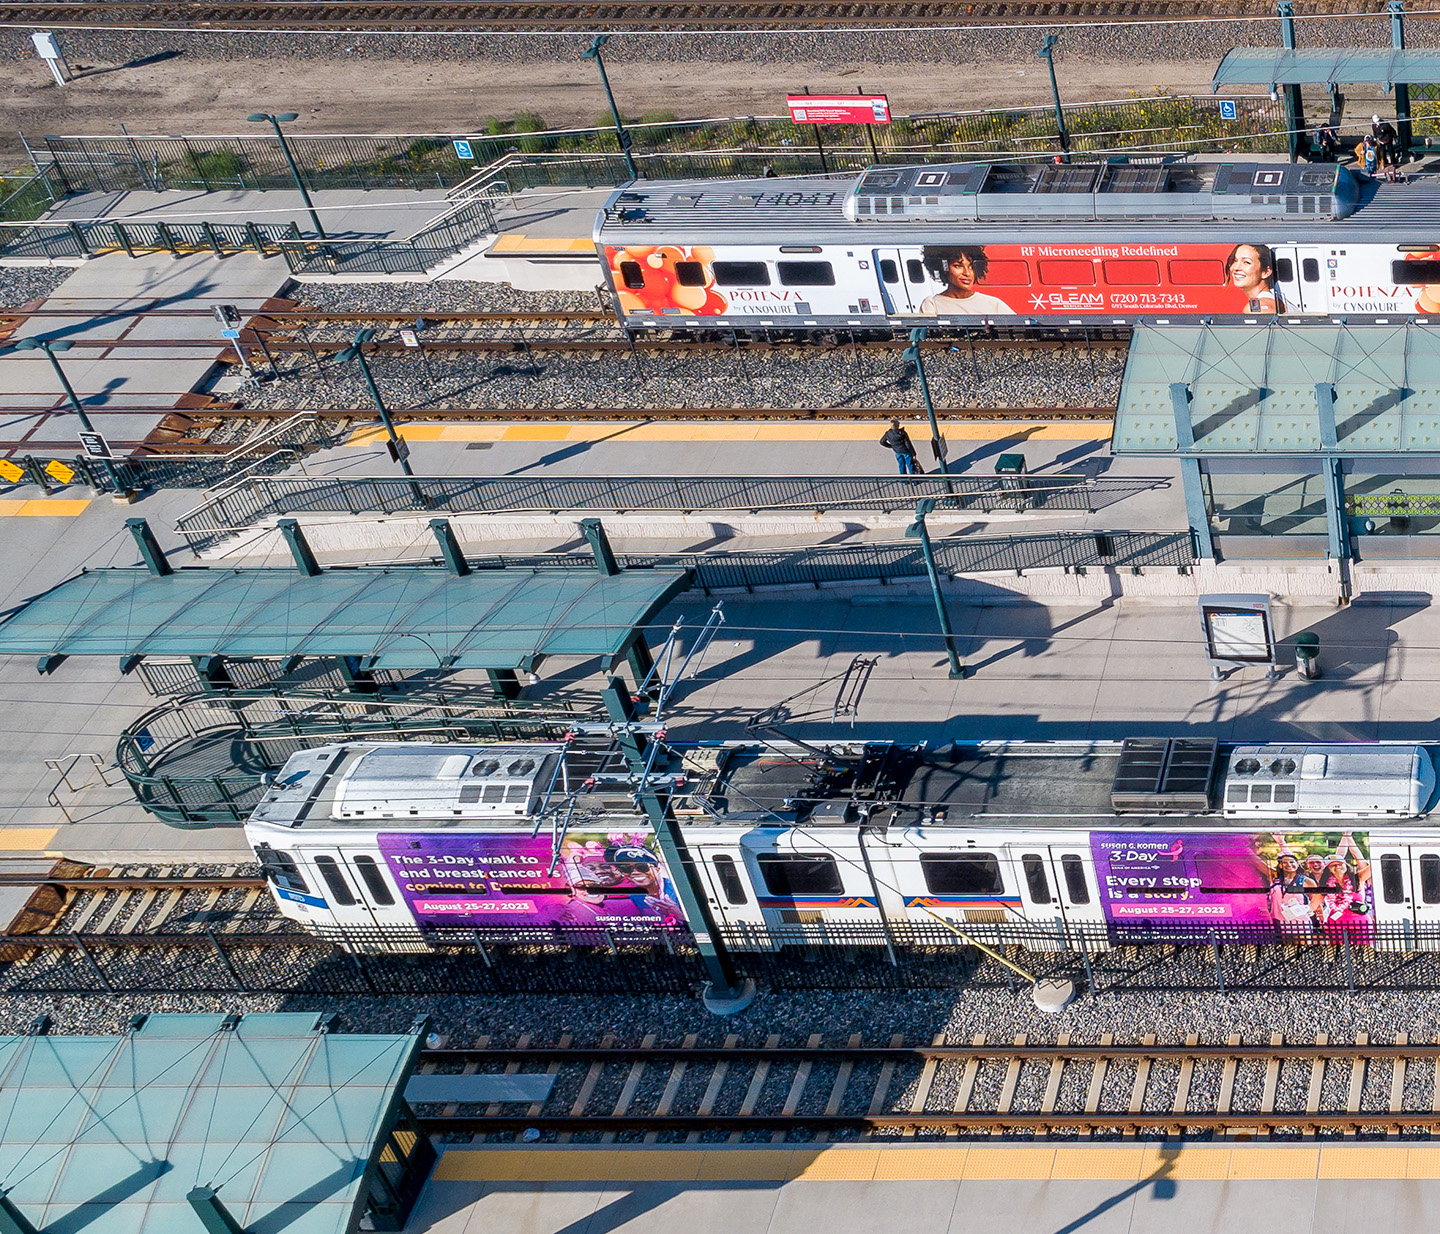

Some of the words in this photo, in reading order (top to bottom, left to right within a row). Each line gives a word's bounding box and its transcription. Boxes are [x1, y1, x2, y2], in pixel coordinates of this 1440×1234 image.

[1021, 247, 1035, 256] RF
[1039, 246, 1119, 258] Microneedling
[1122, 246, 1178, 256] Redefined
[730, 291, 803, 301] POTENZA
[1331, 286, 1413, 298] POTENZA
[1048, 293, 1104, 303] GLEAM
[1110, 293, 1138, 303] (720)
[1139, 293, 1185, 303] 713-7343
[743, 305, 794, 314] CYNOSURE
[1343, 301, 1400, 312] CYNOSURE
[390, 855, 423, 864] The
[426, 855, 474, 866] 3-Day
[479, 855, 516, 864] walk
[520, 856, 539, 864] to
[399, 868, 431, 878] end
[434, 868, 485, 878] breast
[490, 870, 547, 878] cancer
[1106, 875, 1157, 887] Every
[1162, 876, 1202, 888] step
[1108, 888, 1123, 898] is
[423, 902, 462, 911] August
[465, 902, 500, 911] 25-27,
[501, 902, 530, 910] 2023
[1119, 906, 1158, 915] August
[1160, 906, 1195, 915] 25-27,
[1196, 906, 1225, 914] 2023
